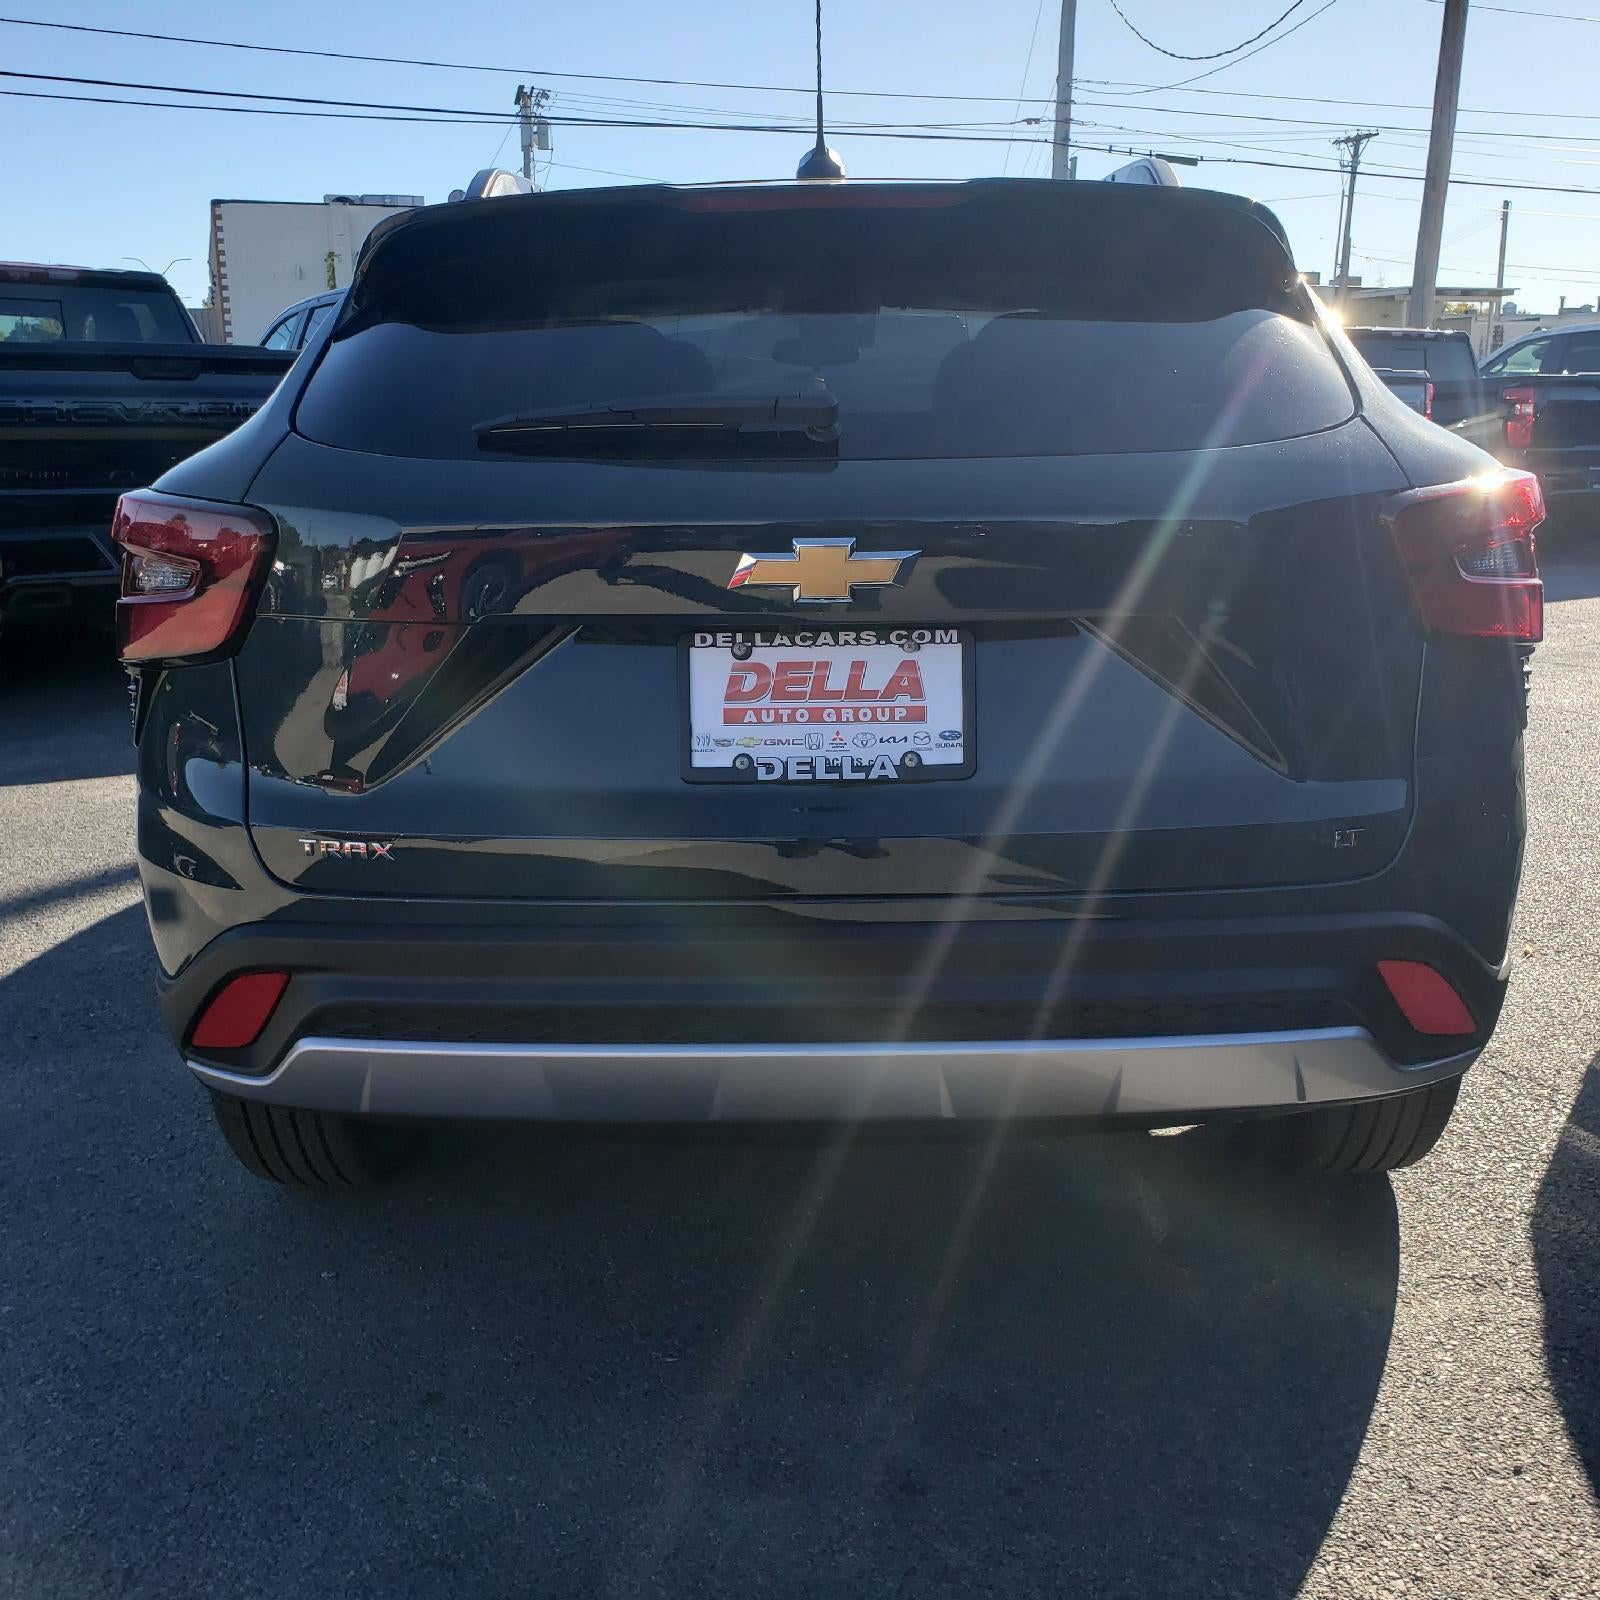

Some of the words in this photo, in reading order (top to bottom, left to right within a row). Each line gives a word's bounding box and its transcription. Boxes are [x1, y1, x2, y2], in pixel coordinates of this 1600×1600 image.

[694, 630, 959, 648] DELLACARS.COM
[723, 659, 927, 704] DELLA
[743, 708, 809, 723] AUTO
[823, 706, 908, 722] GROUP
[763, 738, 804, 746] GMC
[756, 754, 899, 781] DELLA
[298, 838, 396, 861] TRAX
